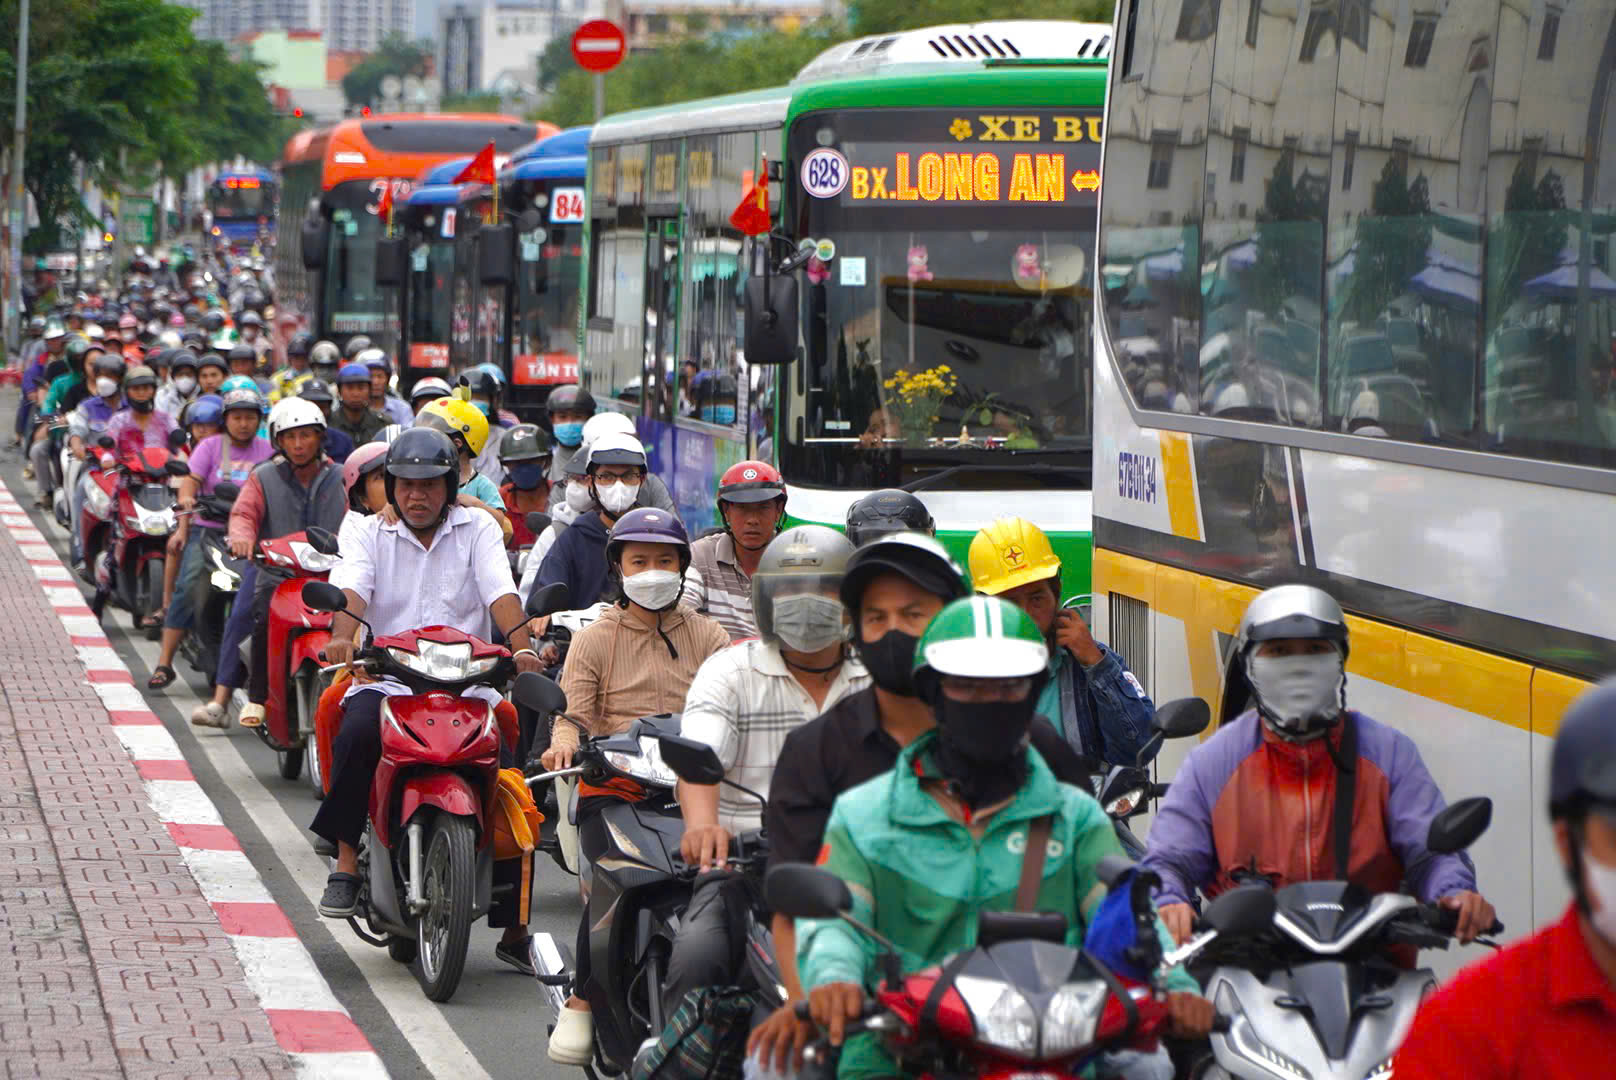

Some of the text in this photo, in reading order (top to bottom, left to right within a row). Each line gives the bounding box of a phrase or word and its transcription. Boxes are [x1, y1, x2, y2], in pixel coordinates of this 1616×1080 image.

[978, 115, 1040, 142] XE
[808, 157, 840, 188] 628
[1008, 153, 1065, 202] AN
